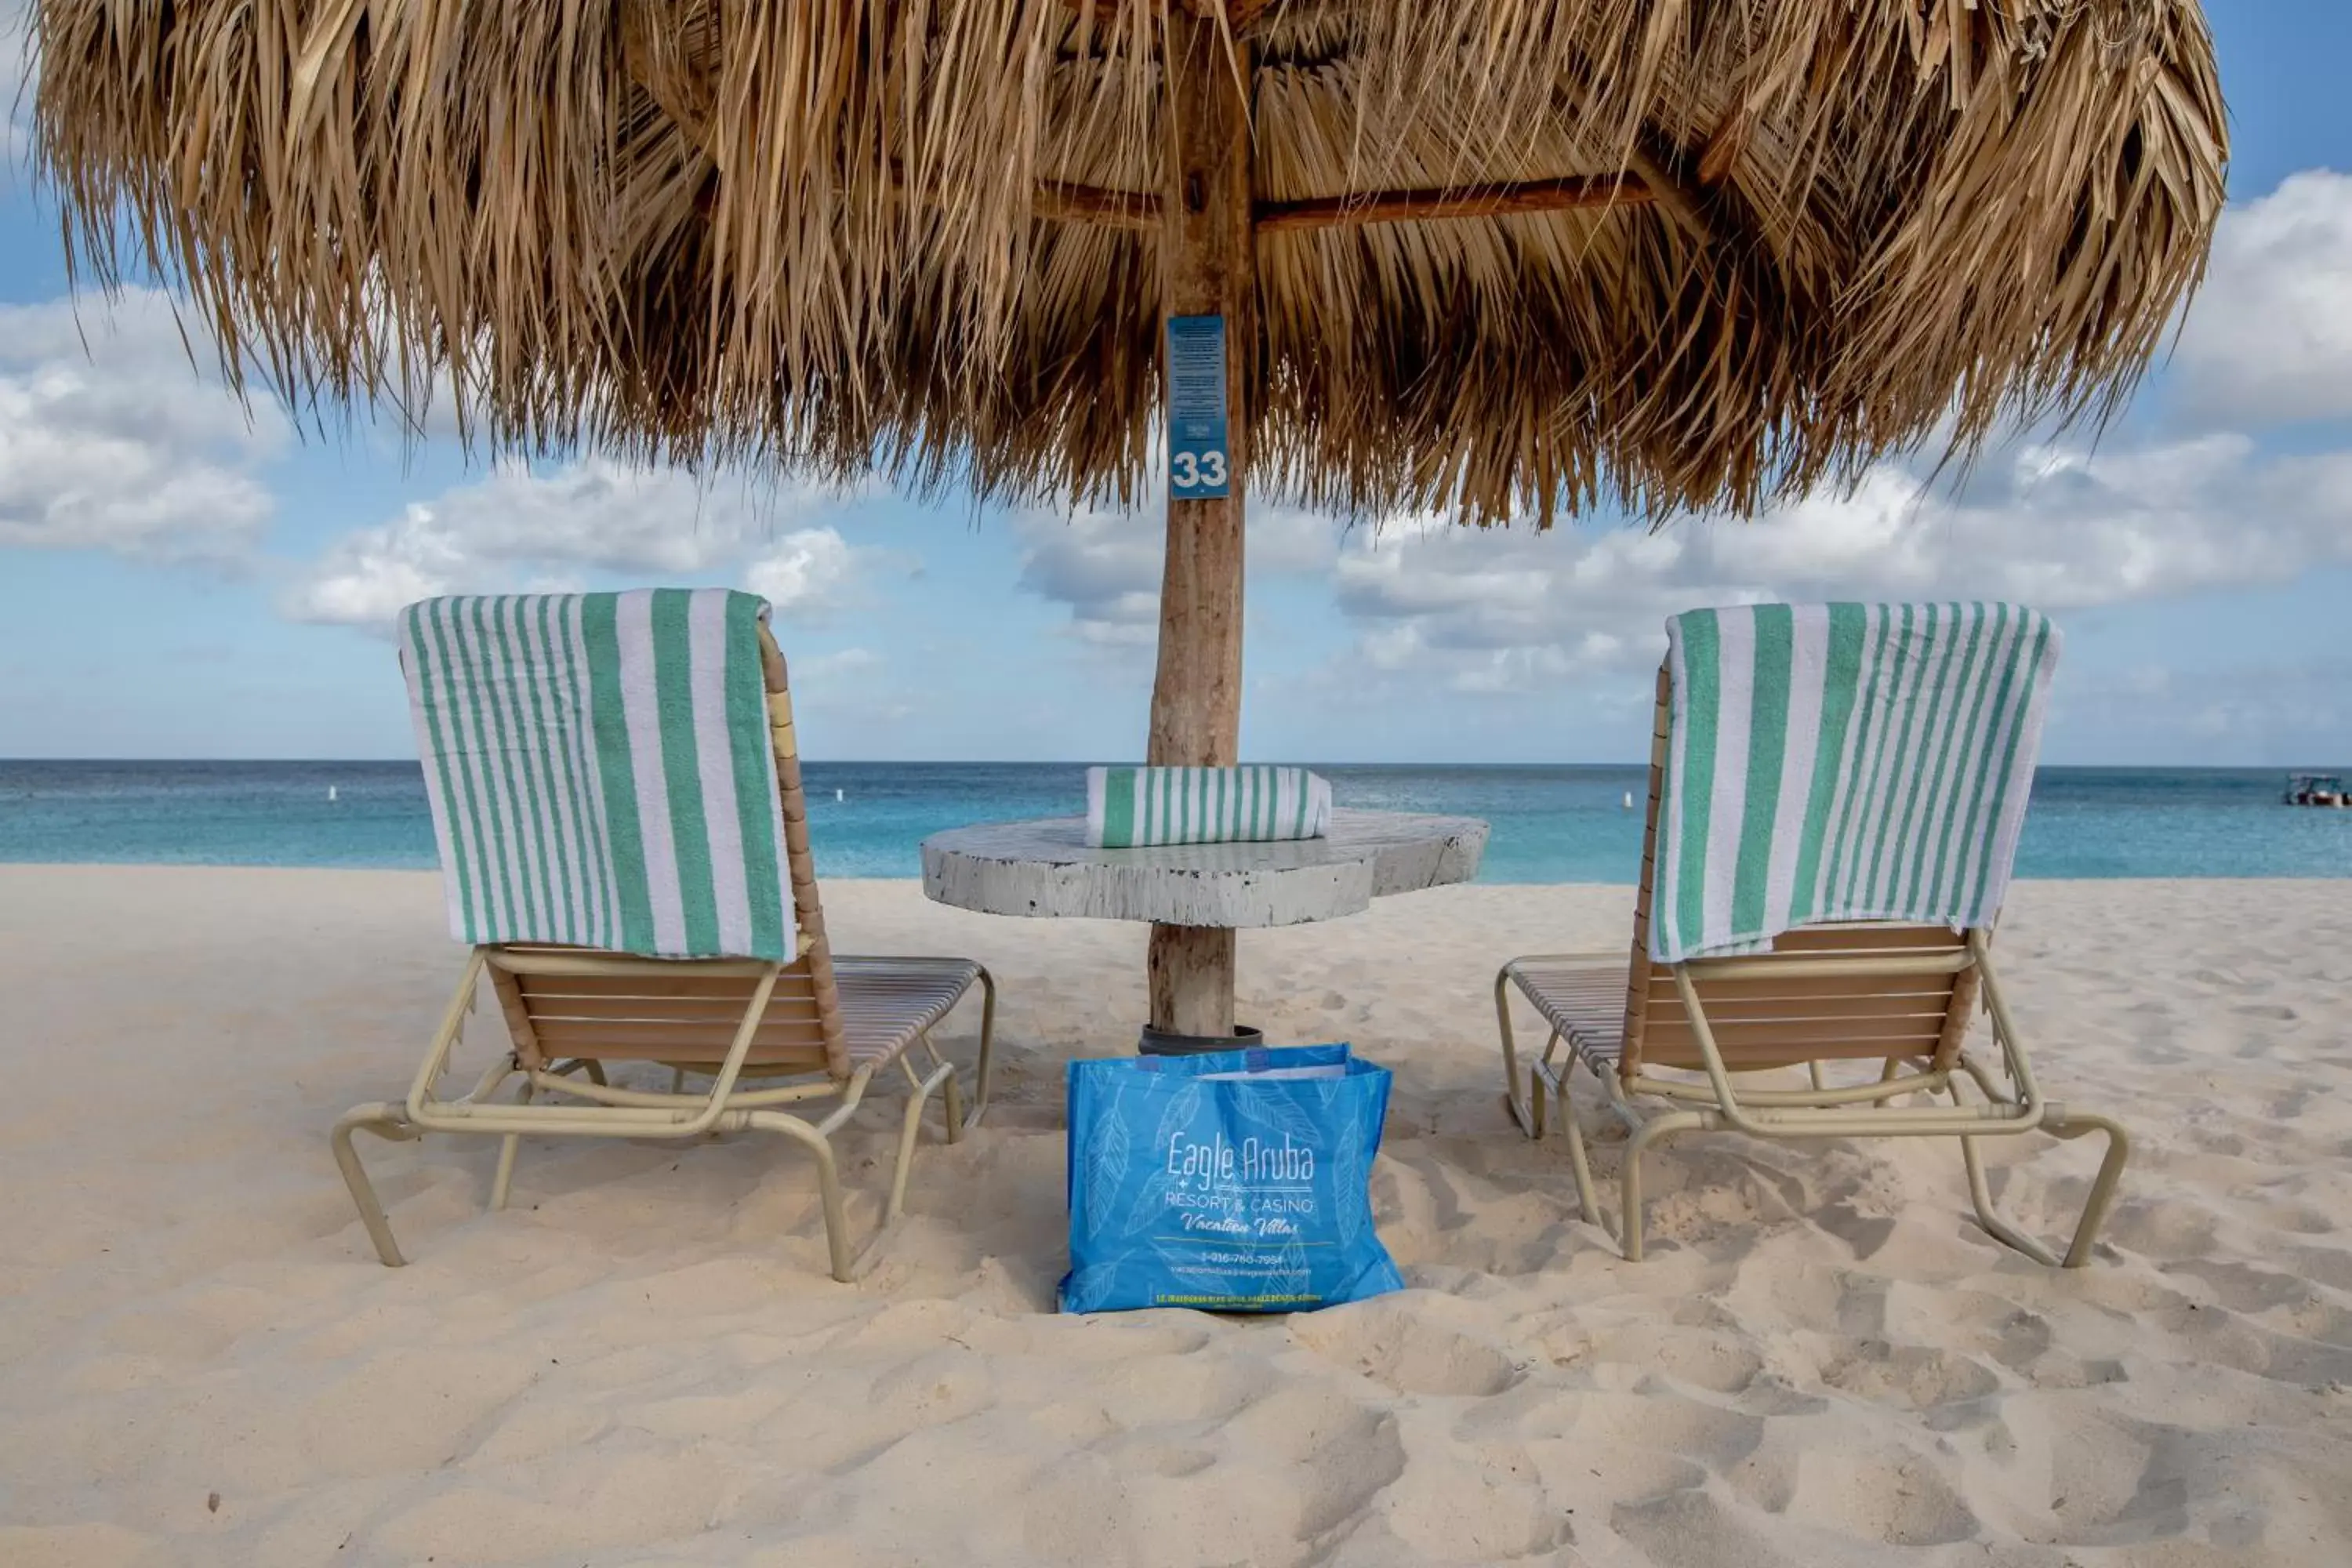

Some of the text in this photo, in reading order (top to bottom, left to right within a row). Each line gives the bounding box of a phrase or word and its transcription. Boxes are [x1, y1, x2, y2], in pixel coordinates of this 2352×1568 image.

[1174, 451, 1227, 488] 33
[1167, 1131, 1314, 1191] Eagle Aruba
[1165, 1191, 1231, 1211] RESORT
[1250, 1198, 1314, 1214] CASINO
[1180, 1213, 1300, 1237] Vacation Villas
